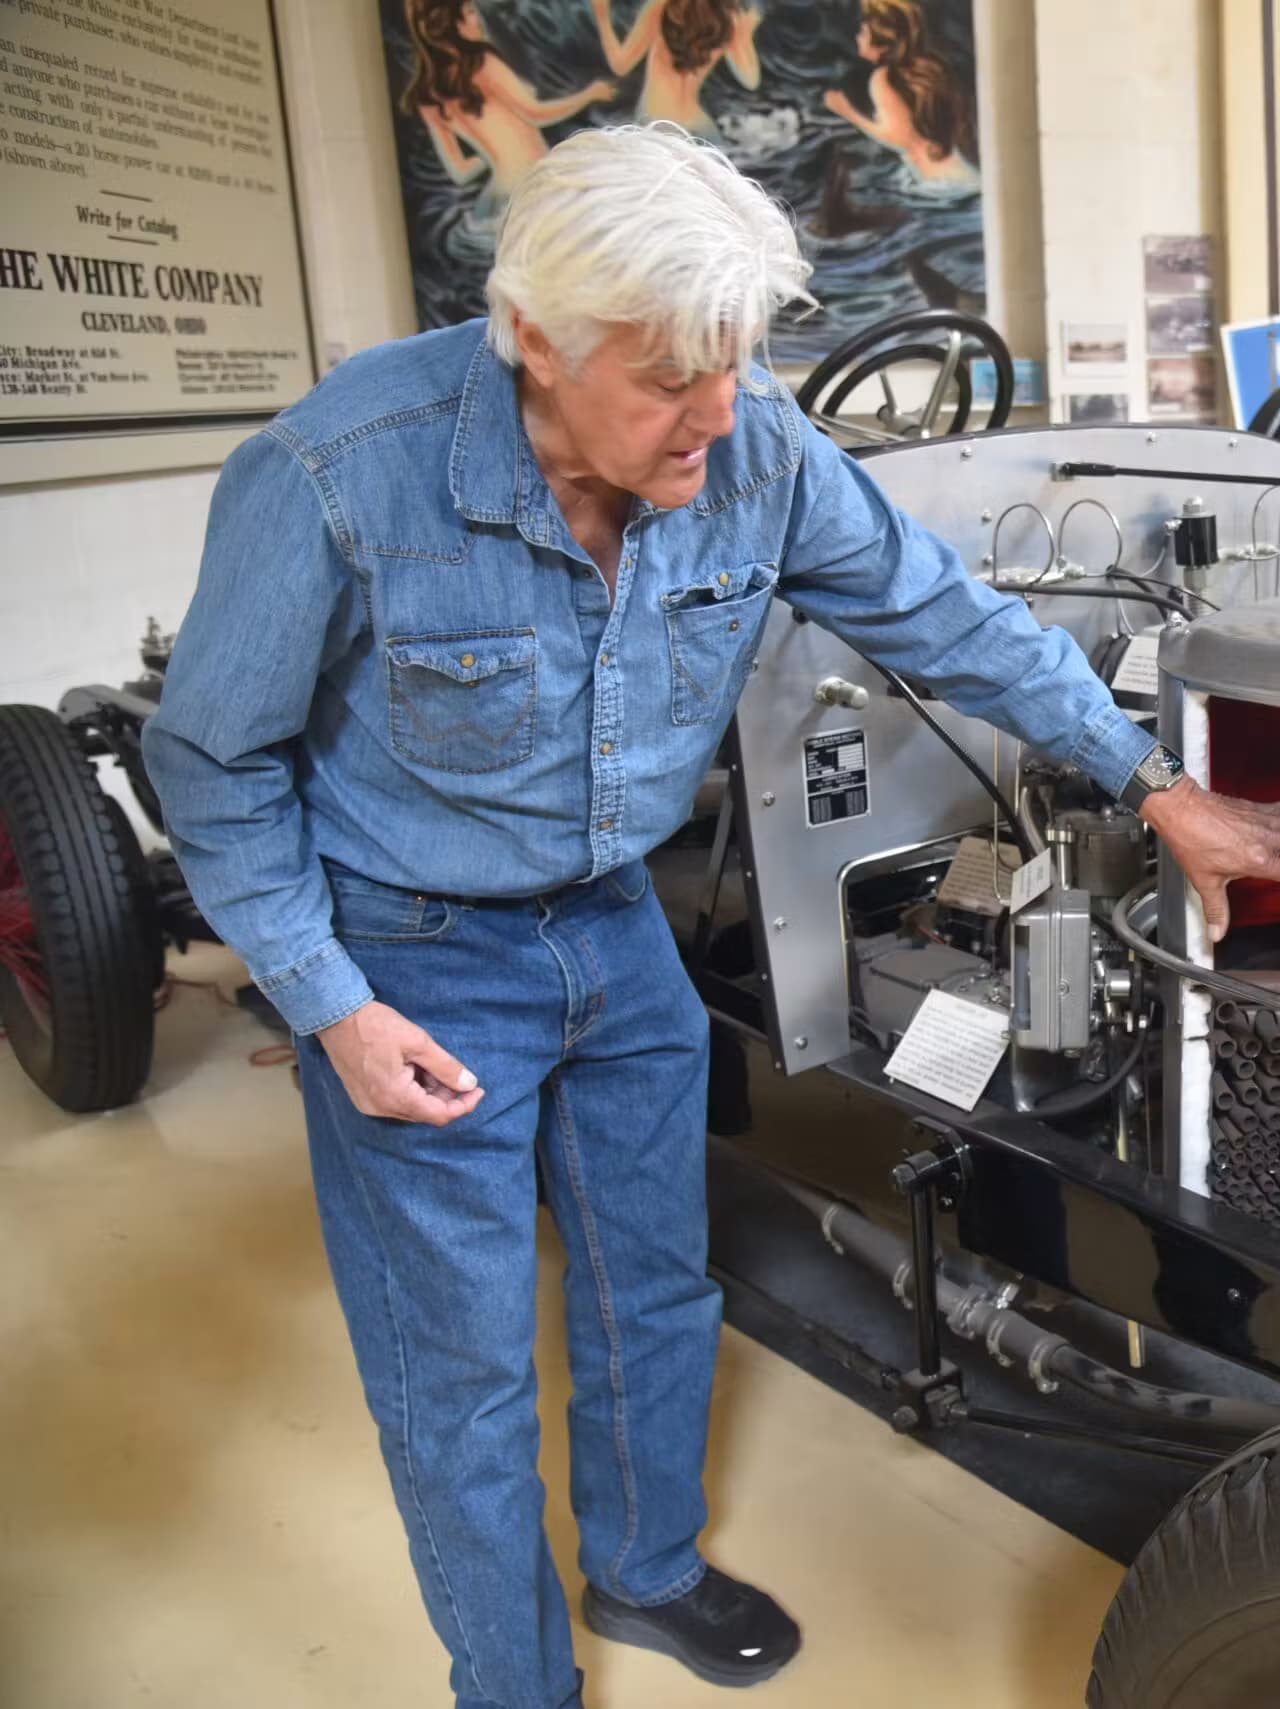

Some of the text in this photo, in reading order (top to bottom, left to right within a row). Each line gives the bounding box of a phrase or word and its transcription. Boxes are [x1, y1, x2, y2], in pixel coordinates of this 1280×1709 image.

[21, 45, 80, 72] unequaled
[12, 63, 55, 85] anyone
[57, 74, 81, 91] who
[4, 81, 42, 105] acting
[48, 92, 74, 110] with
[9, 105, 80, 132] construction
[76, 205, 178, 240] Write for Catalog
[0, 248, 263, 308] HE WHITE COMPANY
[81, 310, 172, 336] CLEVELAND,
